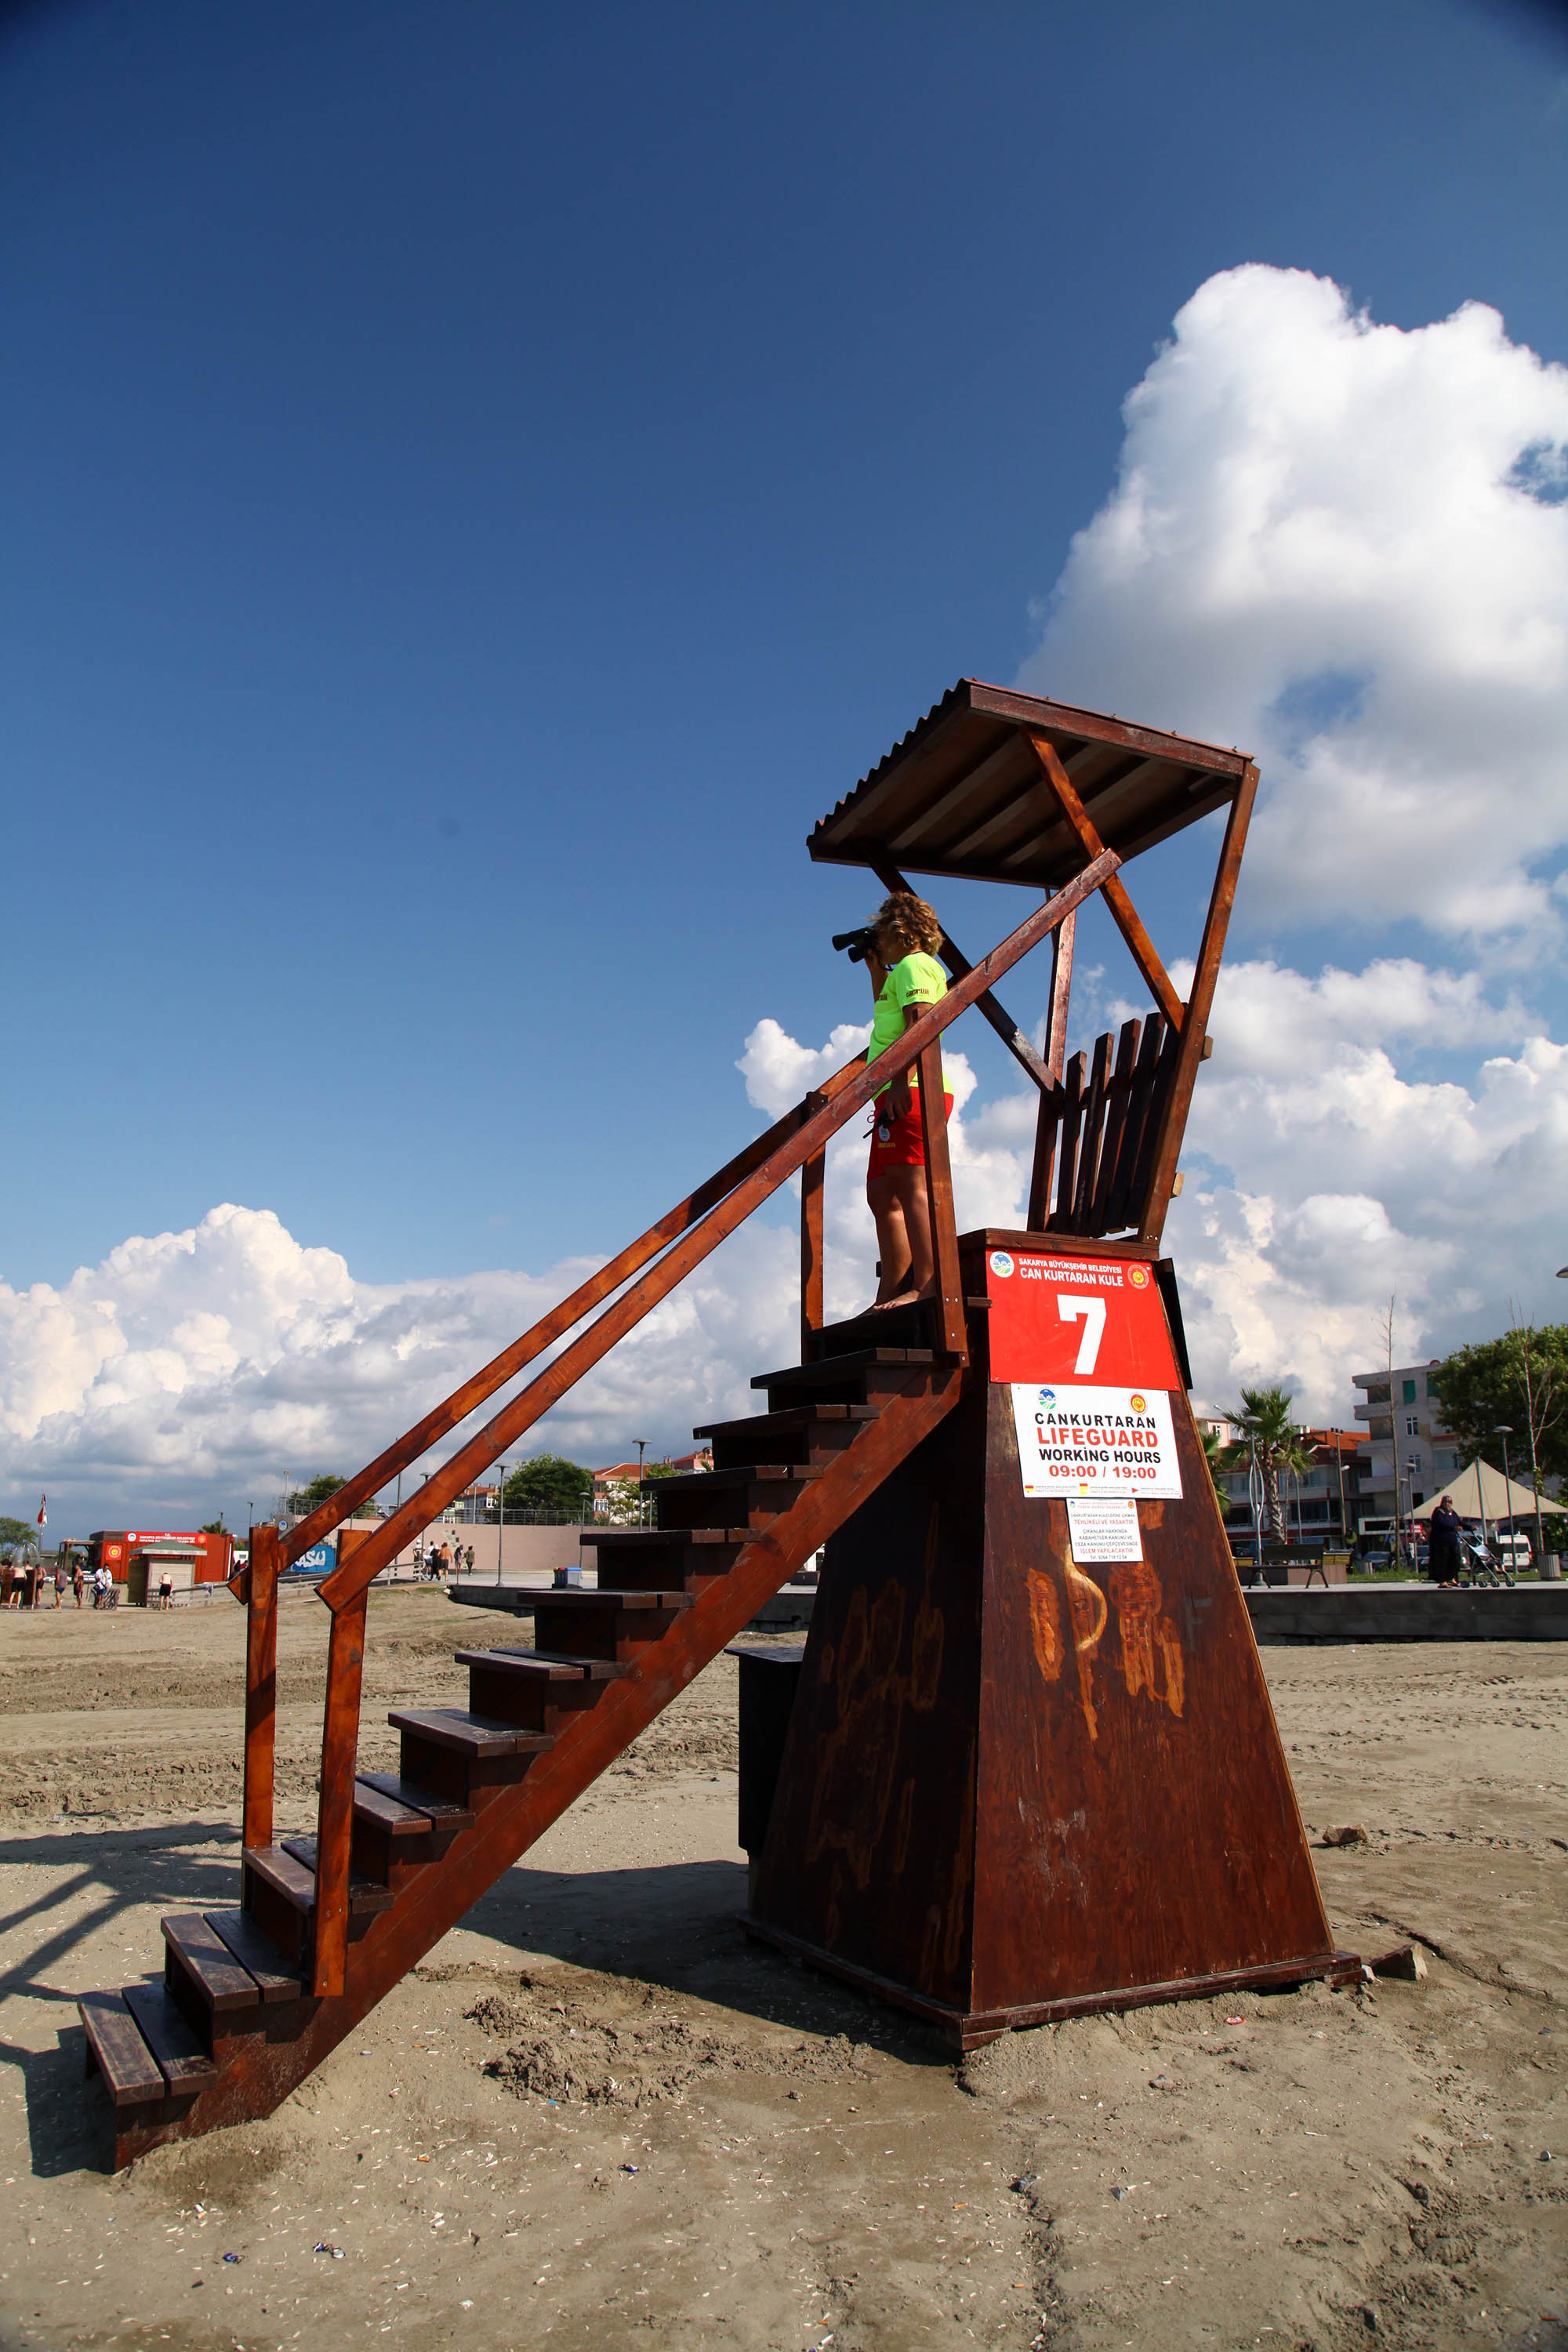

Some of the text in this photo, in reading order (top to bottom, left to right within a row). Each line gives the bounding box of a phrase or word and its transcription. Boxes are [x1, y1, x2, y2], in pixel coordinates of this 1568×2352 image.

[1018, 1258, 1122, 1274] SAKARYA BÜYÜKŞEHİR BELEDİYESİ
[1020, 1267, 1123, 1287] CAN KURTARAN KULE
[1057, 1294, 1106, 1374] 7
[1034, 1413, 1156, 1428] CANKURTARAN
[1036, 1427, 1158, 1447] LIFEGUARD
[1039, 1446, 1161, 1464] WORKİNG HOURS
[1049, 1465, 1156, 1479] 09:00 / 19:00
